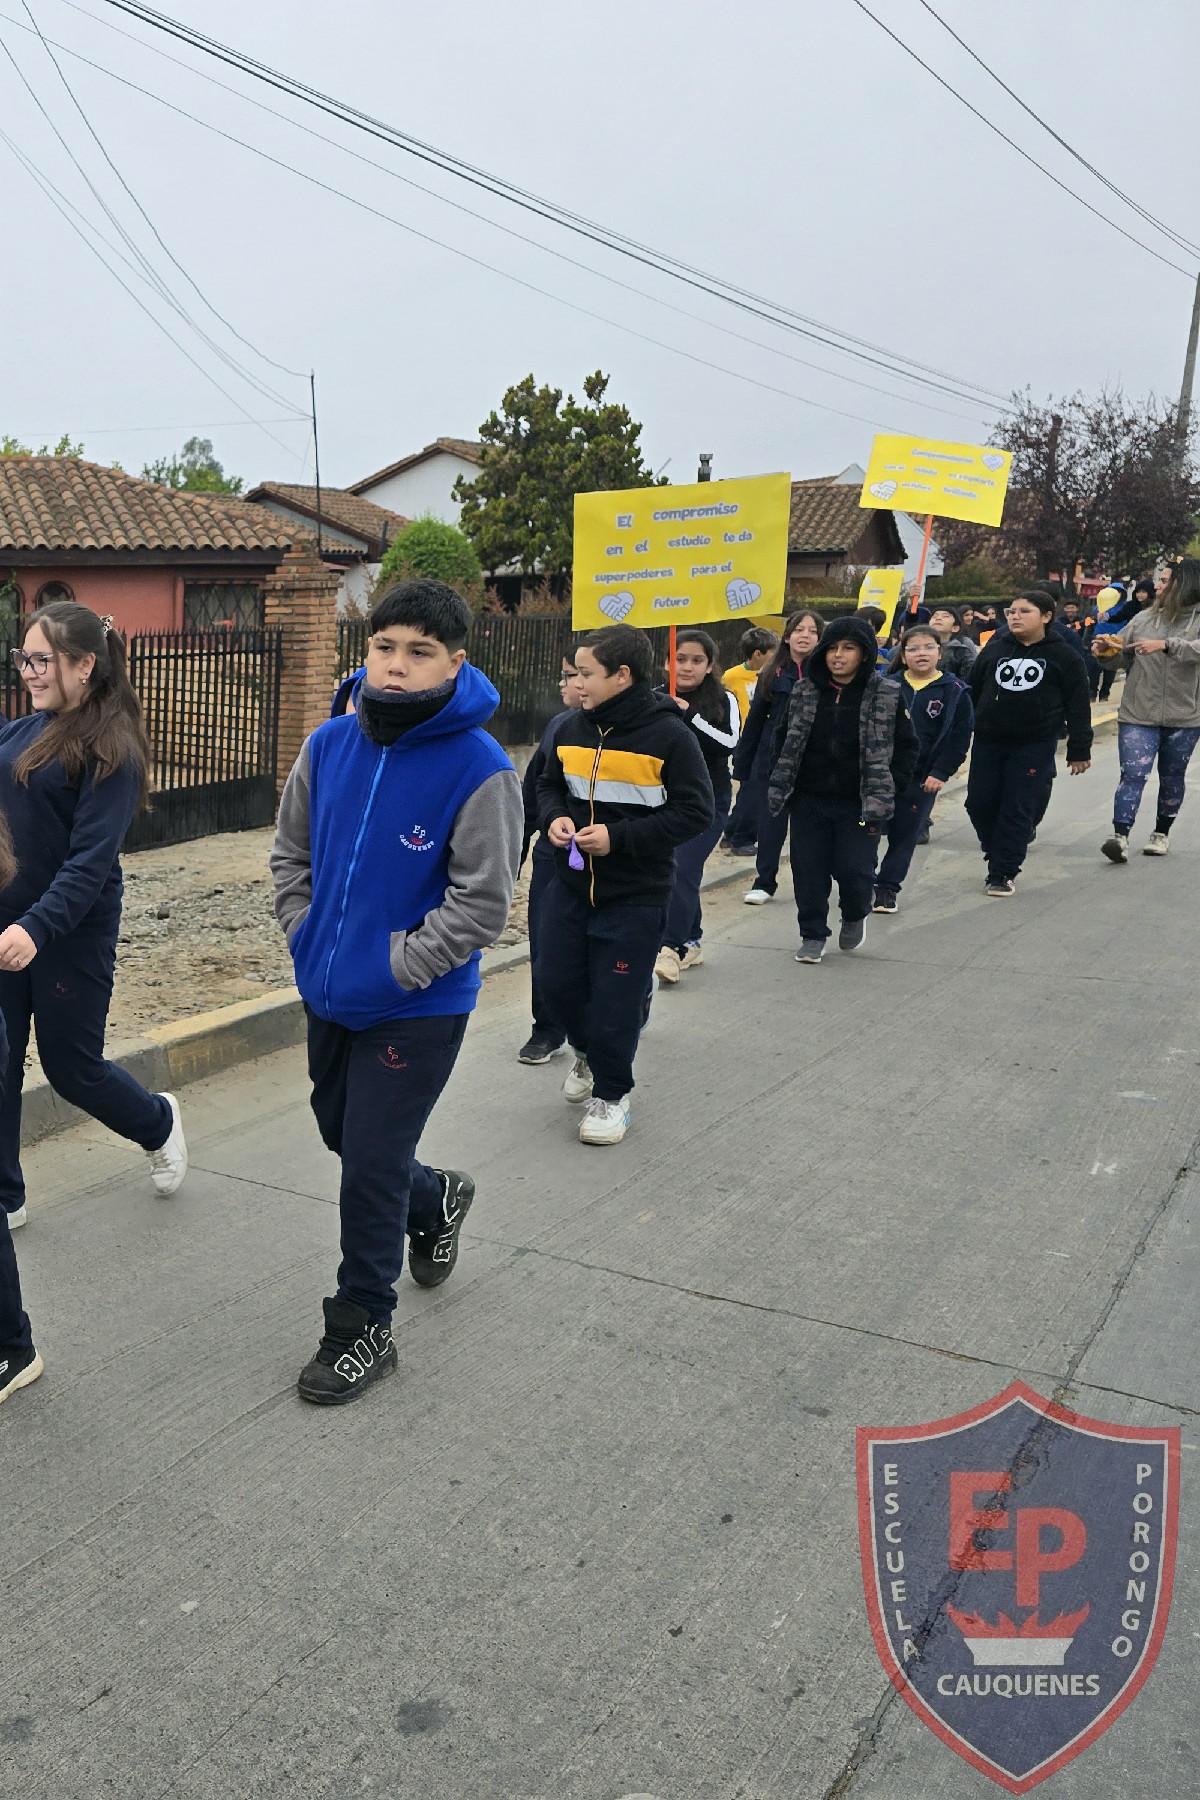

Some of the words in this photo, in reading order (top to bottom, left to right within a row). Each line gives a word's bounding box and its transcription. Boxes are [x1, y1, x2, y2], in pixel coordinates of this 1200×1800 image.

[617, 515, 632, 528] El
[653, 503, 738, 521] compromiso
[606, 545, 623, 555] en
[635, 540, 649, 552] el
[668, 533, 711, 547] estudio
[691, 566, 717, 578] para
[721, 561, 732, 572] el
